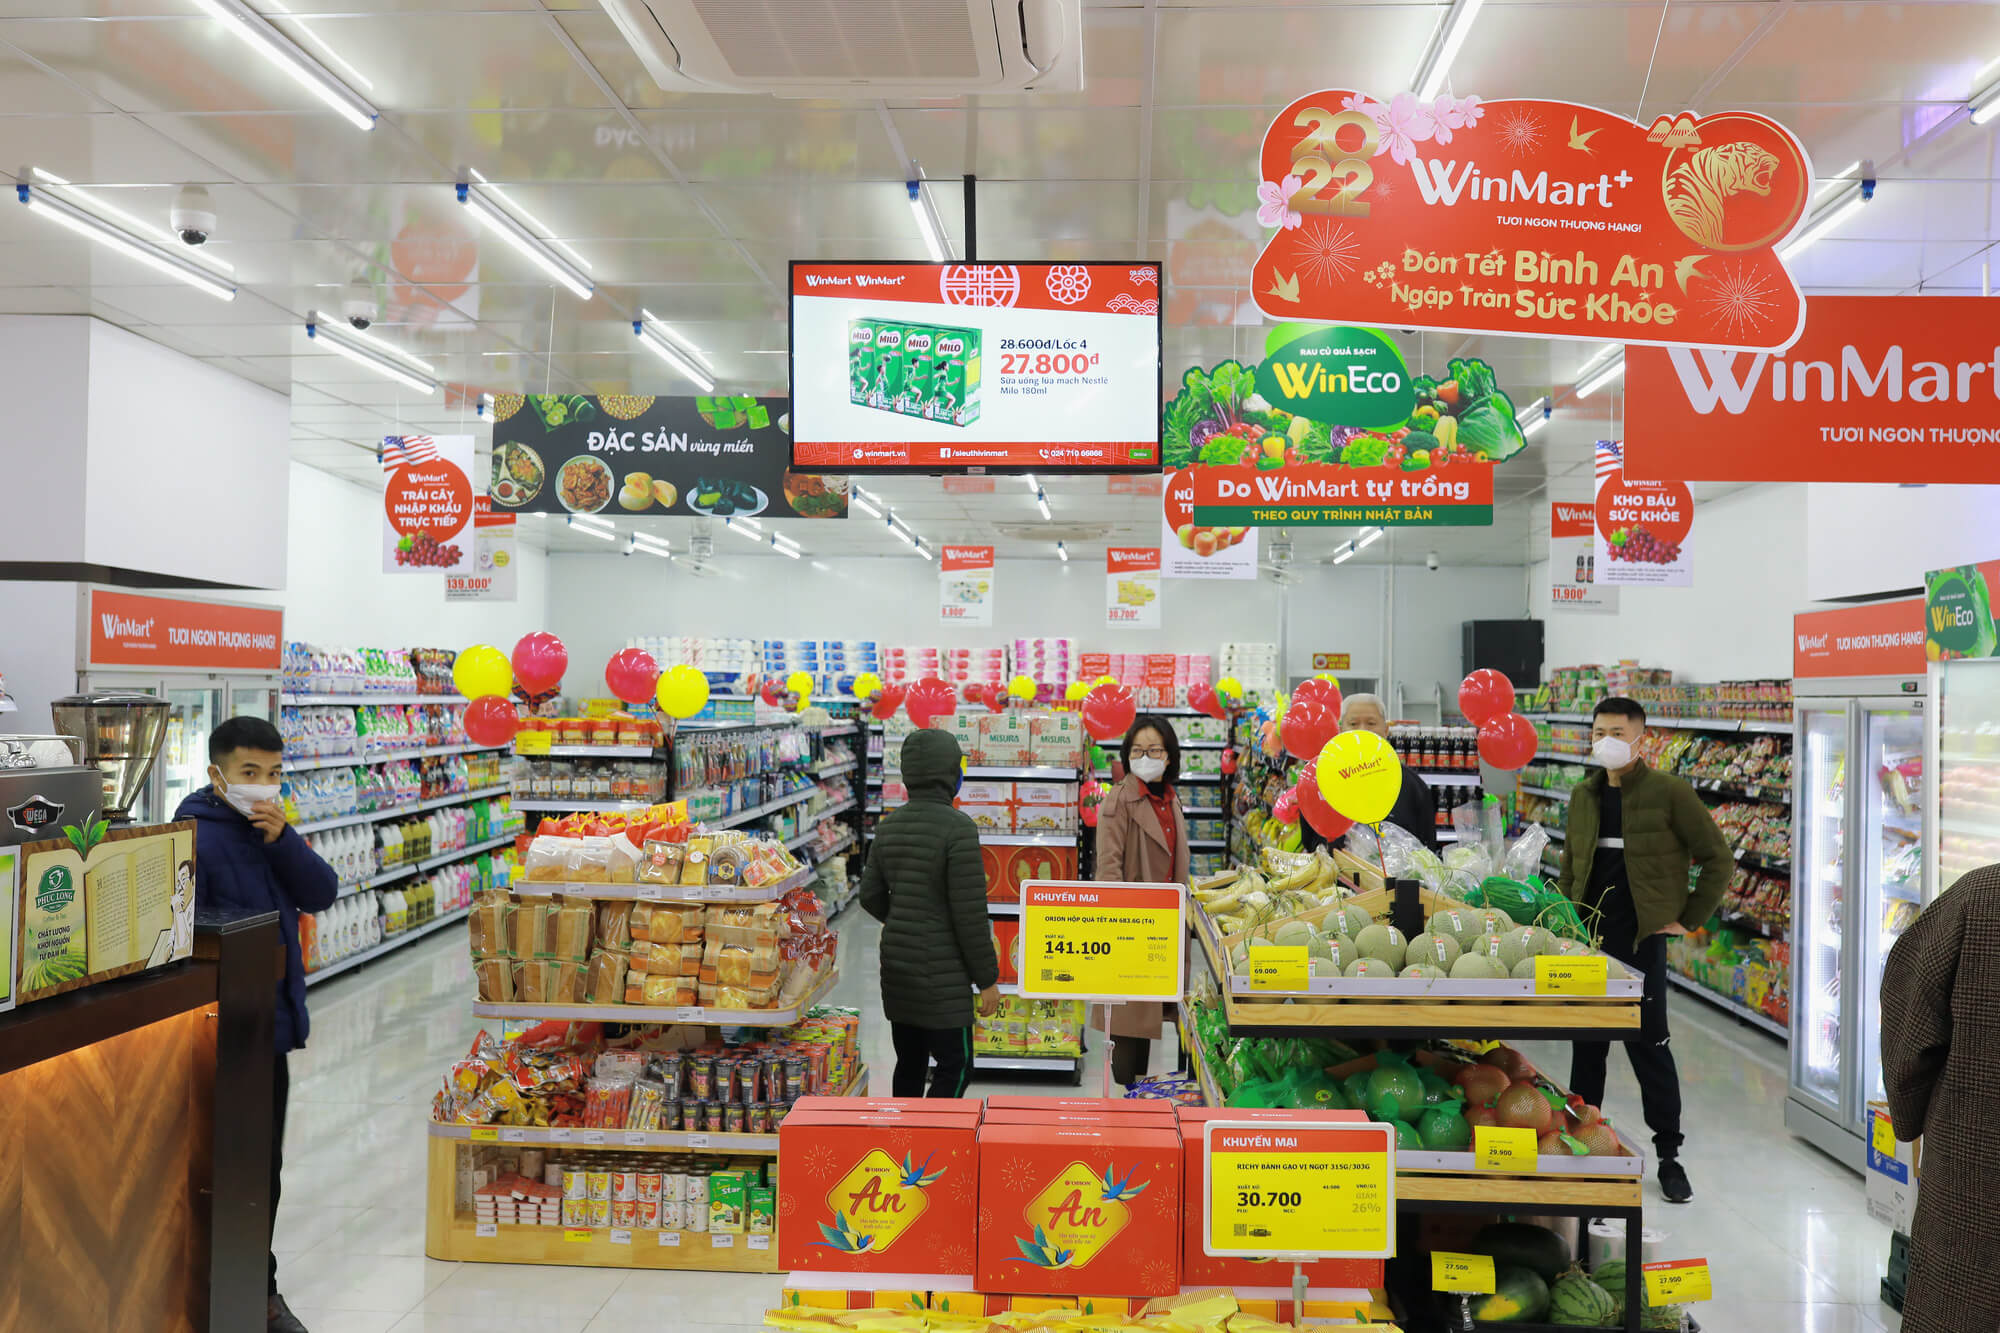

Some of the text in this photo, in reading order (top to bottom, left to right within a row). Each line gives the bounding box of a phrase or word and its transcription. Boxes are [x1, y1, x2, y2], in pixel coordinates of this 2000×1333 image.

[1291, 106, 1379, 163] 20
[1288, 155, 1374, 218] 22
[1411, 157, 1634, 208] WinMart+
[1524, 217, 1558, 228] NGON
[1401, 250, 1665, 289] Đón Tết Bình An
[805, 274, 852, 287] WinMart
[1391, 283, 1675, 325] Ngập Tràn Sức Khỏe
[879, 335, 899, 344] MILO
[908, 339, 929, 348] MILO
[1079, 338, 1087, 350] 4
[939, 343, 961, 352] MILO
[1300, 348, 1318, 356] RAU
[1272, 362, 1401, 399] WinEco
[1000, 386, 1047, 395] Milo 180ml
[586, 426, 636, 456] ĐẶC
[641, 426, 688, 452] SẢN
[689, 439, 720, 456] vùng
[1820, 427, 1864, 442] TƯƠI
[1868, 427, 1925, 443] NGON
[864, 450, 906, 458] winmart.vn
[400, 488, 455, 501] TRÁI CÂY
[1217, 475, 1470, 502] Do WinMart tự trồng
[394, 503, 427, 516] NHẬP
[429, 500, 462, 514] KHẨU
[1613, 495, 1644, 507] KHO
[398, 513, 458, 528] TRỰC TIẾP
[1252, 506, 1433, 522] THEO QUY TRÌNH NHẬT BẢN
[1608, 506, 1680, 522] SỨC KHỎE
[1930, 605, 1974, 633] WinEco
[190, 629, 217, 647] NGON
[1851, 635, 1870, 650] NGON
[1033, 891, 1099, 904] KHUYẾN MẠI
[1045, 940, 1111, 955] 141.100
[1222, 1134, 1298, 1148] KHUYẾN MẠI
[848, 1175, 907, 1217] An
[1237, 1191, 1302, 1207] 30.700
[1047, 1188, 1108, 1231] An
[1352, 1203, 1381, 1214] 26%
